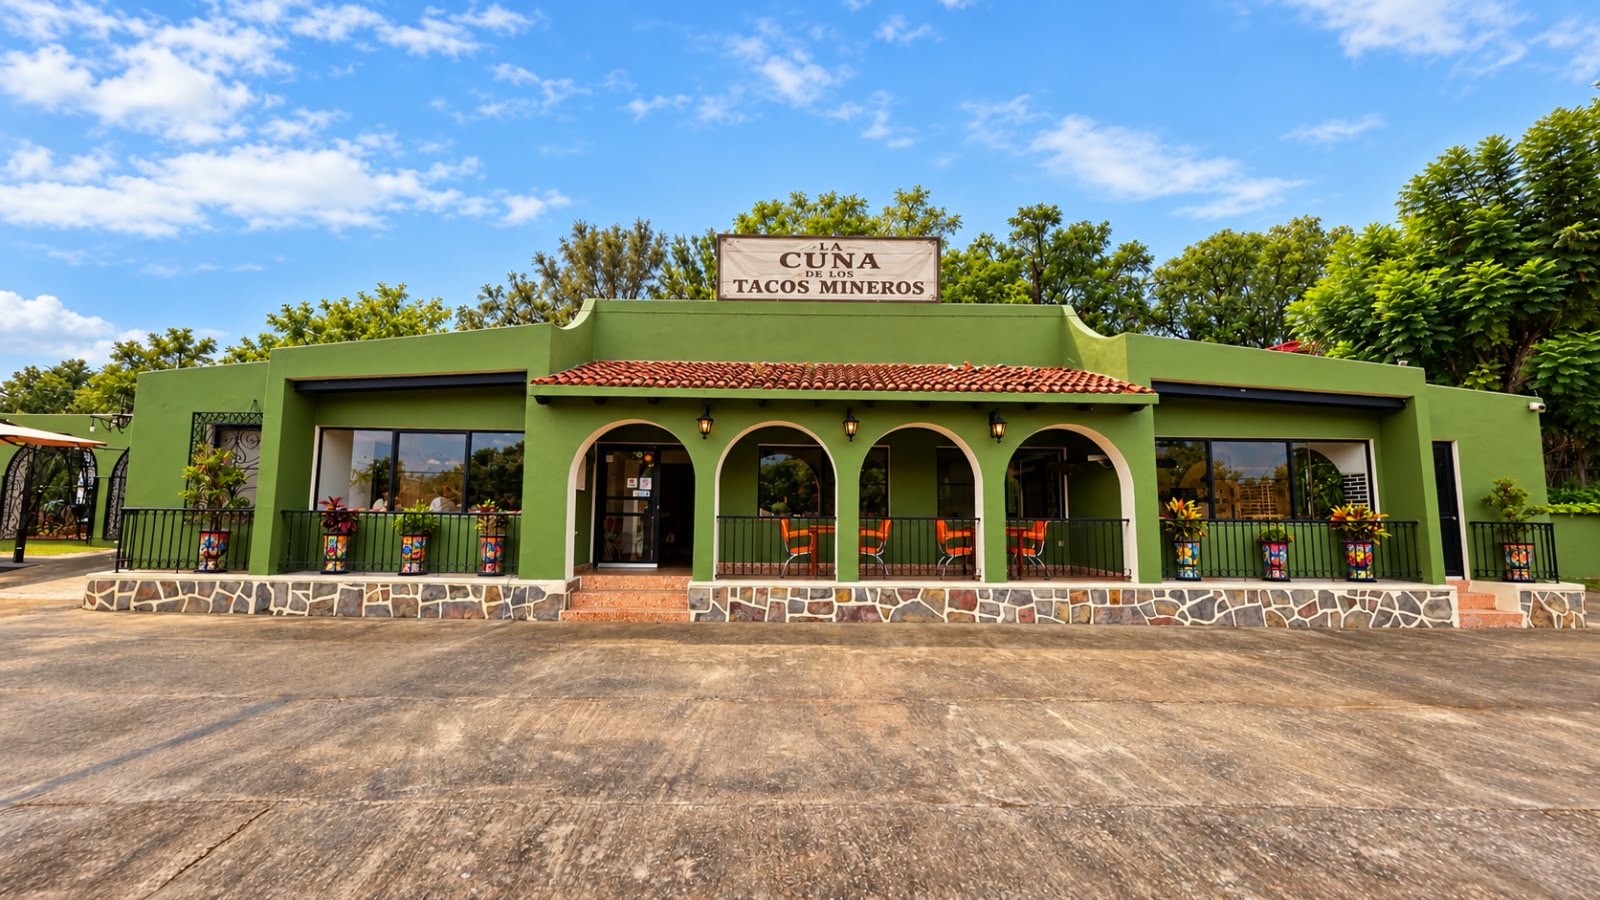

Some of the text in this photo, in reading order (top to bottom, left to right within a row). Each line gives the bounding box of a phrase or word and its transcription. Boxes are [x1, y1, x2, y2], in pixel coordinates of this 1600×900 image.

[819, 242, 843, 251] LA
[779, 252, 881, 269] CUNA
[805, 270, 854, 278] DE LOS
[733, 279, 925, 295] TACOS MINEROS
